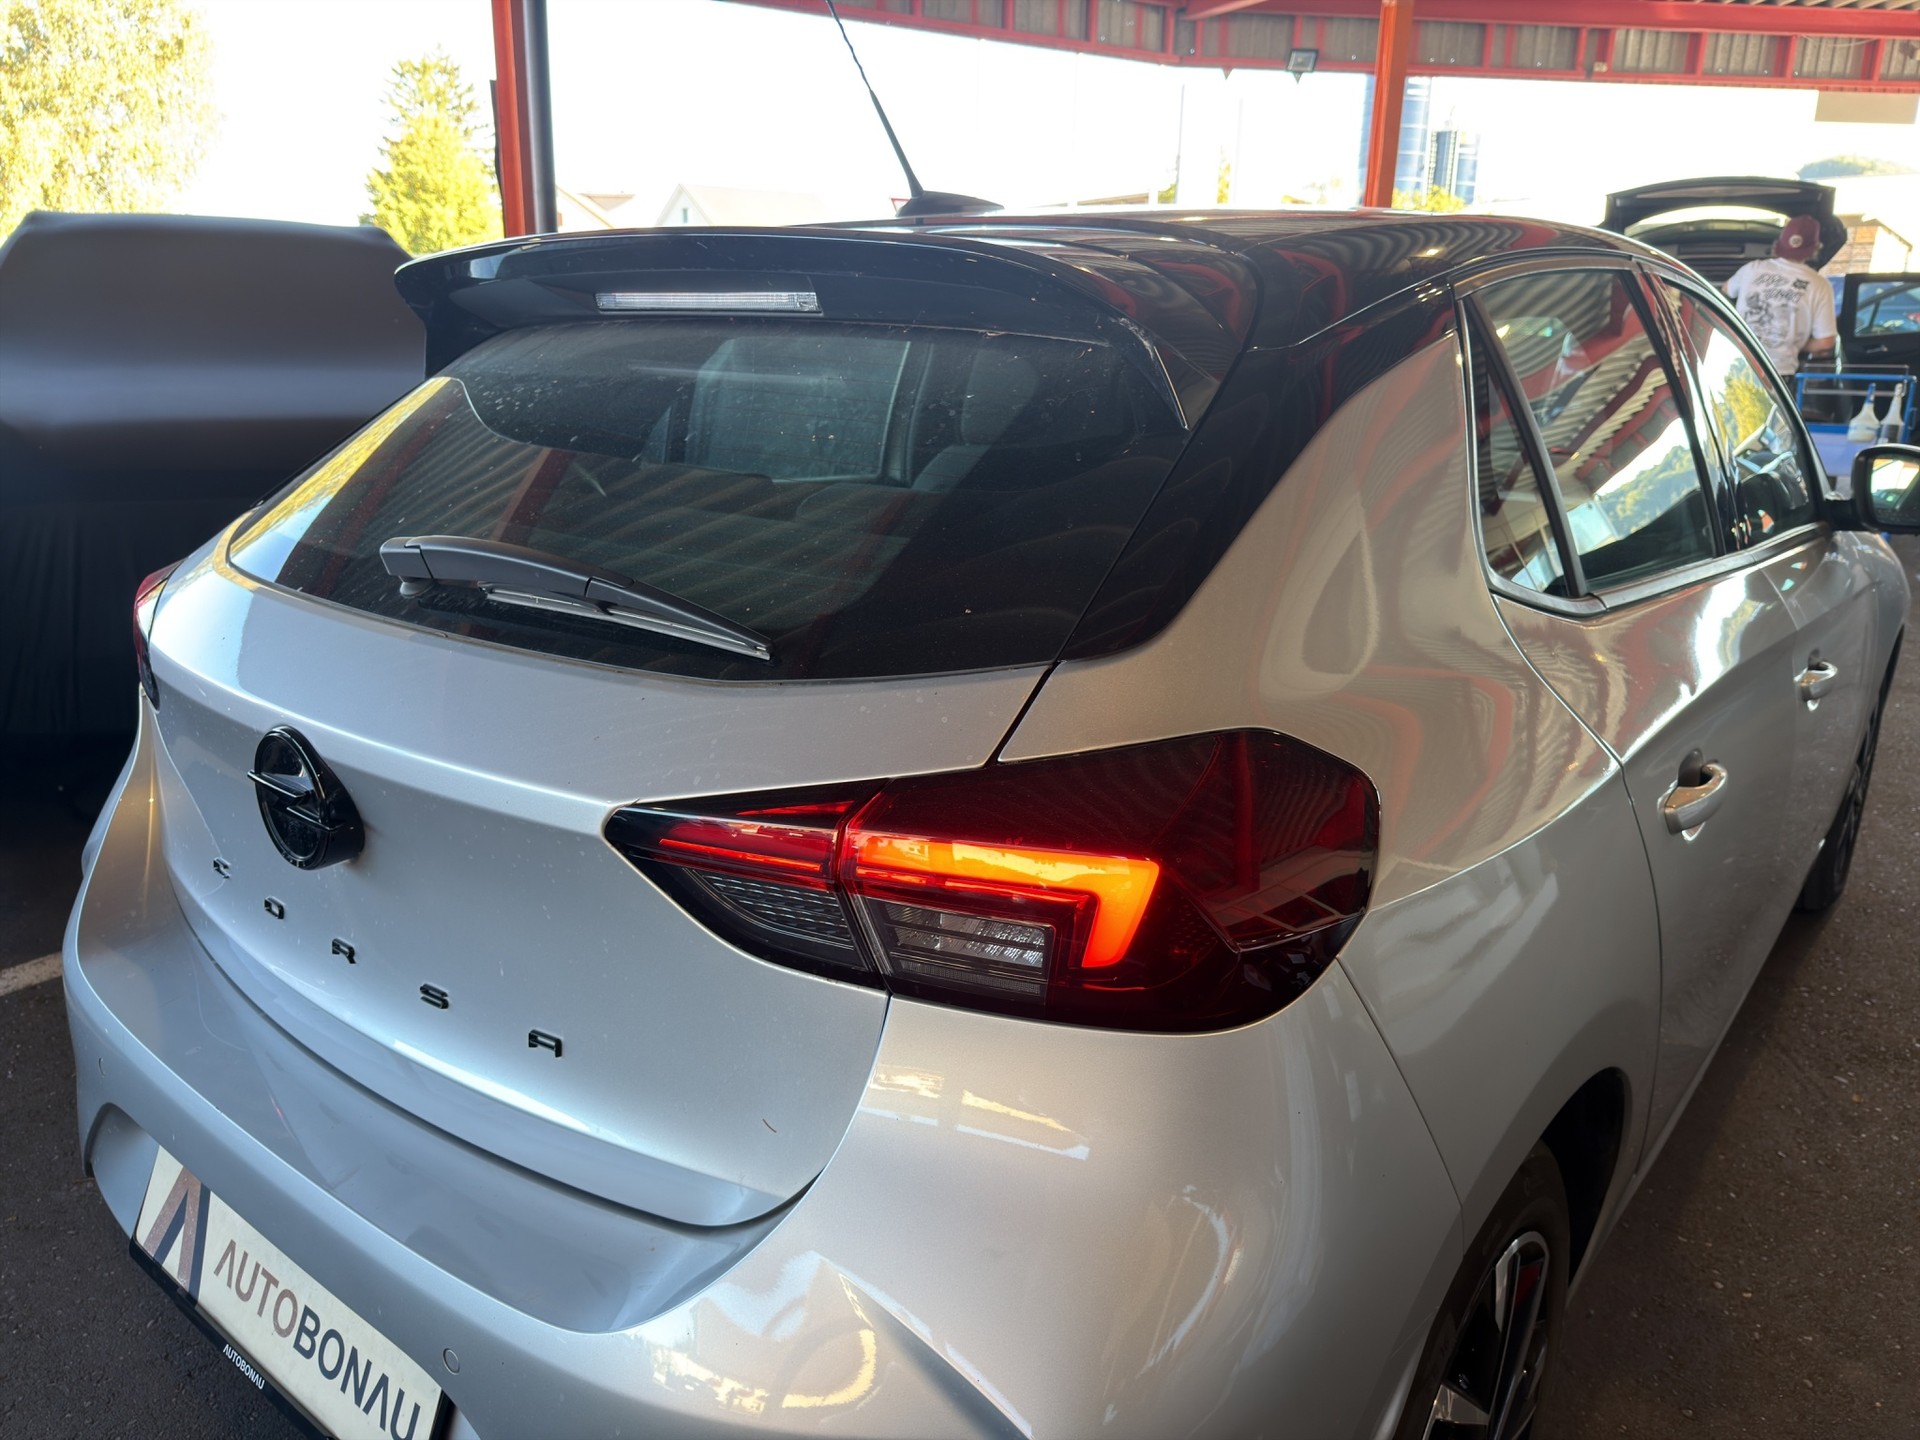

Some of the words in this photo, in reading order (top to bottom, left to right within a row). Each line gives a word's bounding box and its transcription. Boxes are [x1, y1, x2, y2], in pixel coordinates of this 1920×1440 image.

[213, 856, 563, 1058] CORSA
[214, 1239, 422, 1440] AUTOBONAU
[222, 1343, 265, 1390] AUTOBONAU
